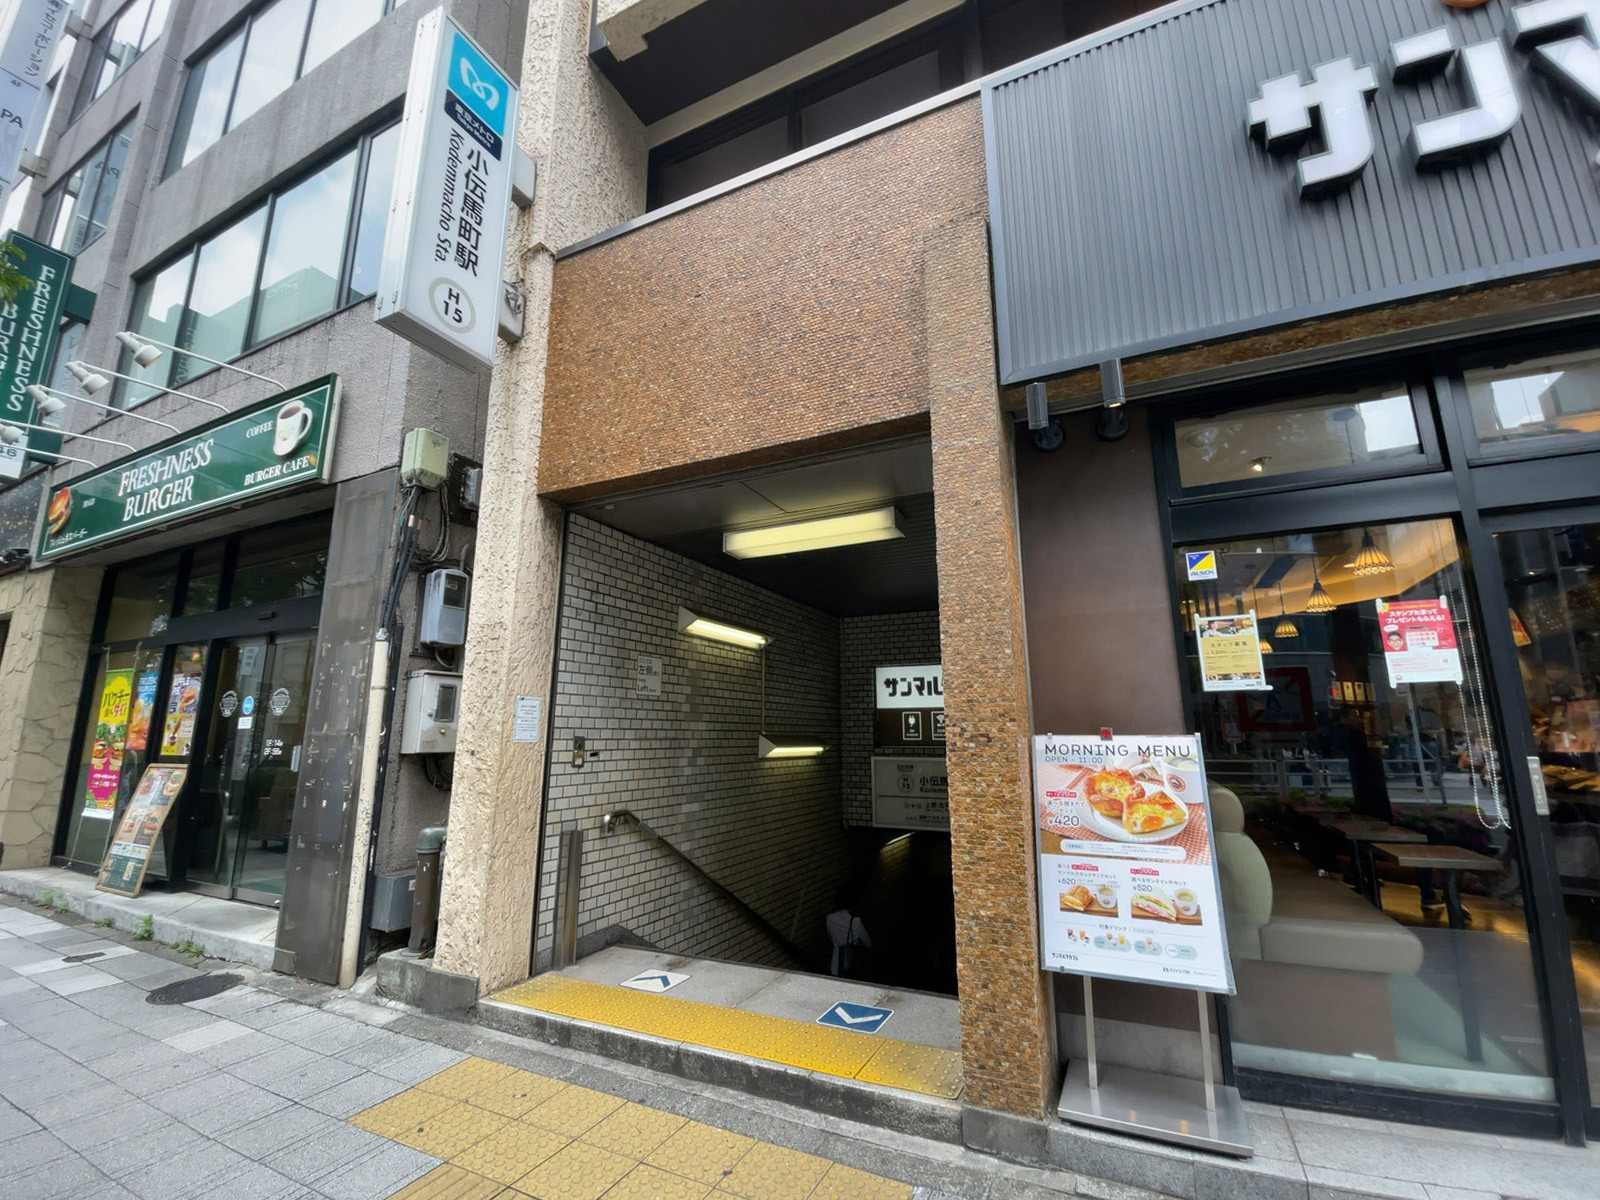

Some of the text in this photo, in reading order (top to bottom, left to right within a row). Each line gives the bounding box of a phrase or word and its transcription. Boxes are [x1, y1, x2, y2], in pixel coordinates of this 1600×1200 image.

[433, 127, 465, 264] Kodemmacho Sta.
[453, 148, 489, 278] 小伝馬町駅
[448, 286, 461, 305] H
[442, 300, 463, 324] 15
[7, 264, 56, 413] FRESHNESS
[246, 420, 274, 438] COFFEE
[118, 438, 214, 497] FRESHNESS
[244, 464, 282, 486] BURGER
[122, 475, 195, 522] BURGER
[883, 676, 943, 697] サンマル
[1045, 743, 1190, 757] MORNING MENU
[1049, 815, 1080, 827] ¥420
[1058, 877, 1077, 885] ¥620
[1133, 883, 1153, 892] ¥520
